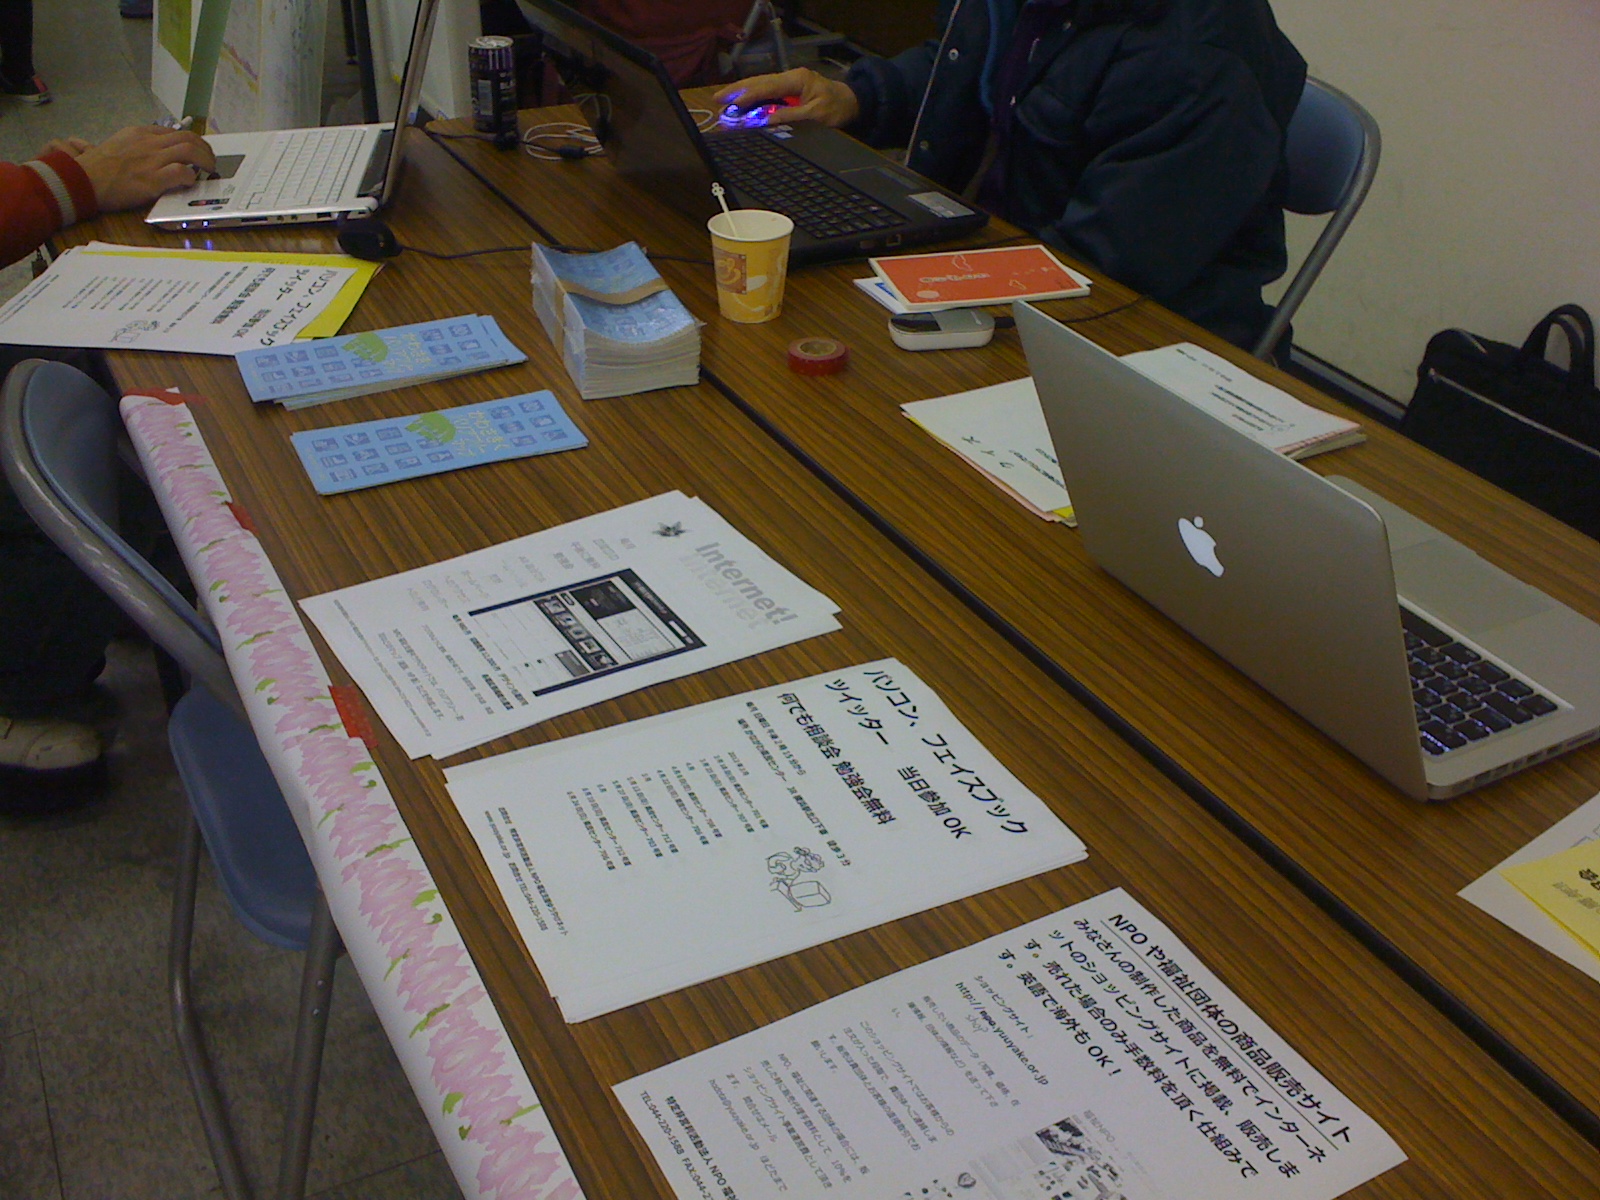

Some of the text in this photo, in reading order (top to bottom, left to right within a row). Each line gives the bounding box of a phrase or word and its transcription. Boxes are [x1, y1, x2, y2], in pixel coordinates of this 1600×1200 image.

[695, 542, 798, 625] Internet!
[778, 693, 896, 824] 何でも相談会 勉強会無料
[825, 679, 888, 744] ツイッター
[864, 671, 1028, 833] パソコン、フェイスブック
[1025, 939, 1258, 1178] す。売れた場合のみ手数料を頂く仕組みで
[1049, 930, 1300, 1178] ットのショッピングサイトに掲載、販売しま
[1074, 919, 1326, 1163] みなさんの制作した商品を無料でインターネ
